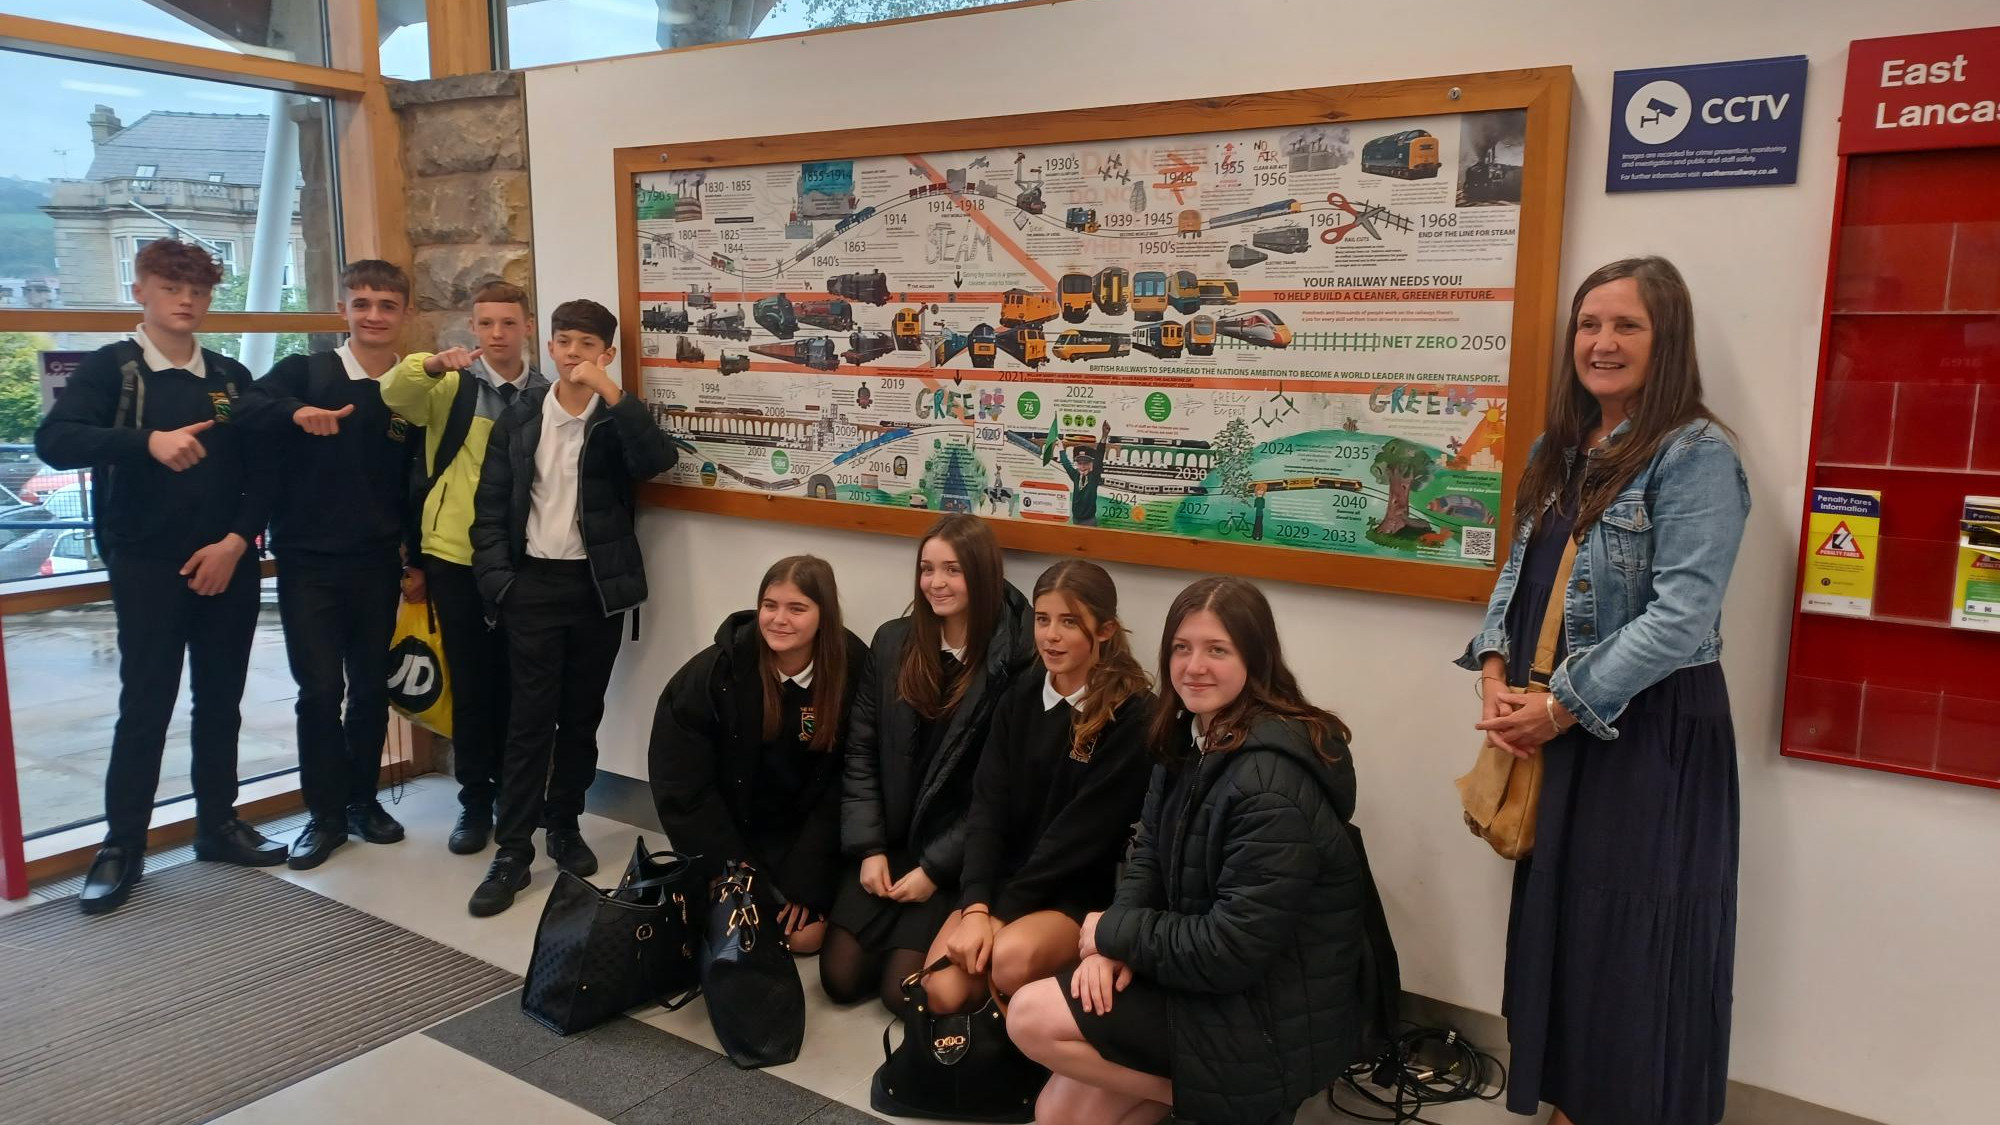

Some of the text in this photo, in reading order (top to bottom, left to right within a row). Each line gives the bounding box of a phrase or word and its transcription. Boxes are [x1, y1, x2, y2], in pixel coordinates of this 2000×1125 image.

[1880, 54, 1968, 88] East
[1701, 93, 1790, 124] CCTV
[1875, 100, 2000, 128] Lanca
[1254, 140, 1268, 151] NO
[1258, 151, 1279, 162] AIR
[1046, 157, 1080, 170] 1930's
[1214, 160, 1244, 174] 1955
[1164, 172, 1192, 184] 1948
[1254, 172, 1286, 186] 1956
[704, 182, 724, 192] 1830
[732, 180, 751, 191] 1855
[928, 201, 952, 212] 1914
[884, 214, 908, 225] 1914
[1104, 214, 1132, 227] 1939
[1145, 212, 1172, 225] 1945
[1310, 213, 1341, 226] 1961
[1420, 213, 1457, 228] 1968
[678, 230, 697, 240] 1804
[720, 230, 740, 240] 1825
[724, 243, 744, 254] 1844
[844, 242, 866, 252] 1863
[1138, 240, 1176, 254] 1950's
[812, 256, 840, 267] 1840's
[1304, 276, 1462, 288] YOUR RAILWAY NEEDS YOU!
[1287, 292, 1312, 300] HELP
[1313, 292, 1342, 300] BUILD
[1344, 292, 1350, 300] A
[1353, 292, 1400, 302] CLEANER,
[1402, 292, 1448, 300] GREENER
[1450, 290, 1495, 300] FUTURE.
[1382, 335, 1506, 350] NET ZERO 2050
[1000, 371, 1024, 382] 2021
[1159, 366, 1200, 374] SPEARHEAD
[1217, 368, 1249, 376] NATIONS
[1250, 368, 1288, 376] AMBITION
[1300, 370, 1333, 378] BECOME
[1446, 374, 1500, 382] TRANSPORT.
[700, 382, 720, 393] 1994
[881, 379, 905, 390] 2019
[652, 388, 676, 399] 1970's
[1066, 386, 1094, 398] 2022
[764, 406, 786, 417] 2008
[1024, 404, 1034, 412] 76
[835, 426, 856, 436] 2009
[747, 447, 767, 456] 2002
[1260, 442, 1294, 456] 2024
[1334, 446, 1369, 460] 2035
[790, 464, 810, 474] 2007
[869, 462, 890, 473] 2016
[1174, 467, 1207, 480] 2030
[836, 474, 859, 484] 2014
[849, 492, 870, 502] 2015
[1109, 492, 1137, 506] 2024
[1332, 494, 1367, 509] 2040
[1818, 494, 1872, 506] Penalty Fares
[1102, 506, 1130, 520] 2023
[1179, 502, 1210, 516] 2027
[1820, 502, 1868, 514] Information
[1276, 525, 1310, 538] 2029
[1322, 528, 1356, 543] 2033
[387, 654, 434, 696] JD
